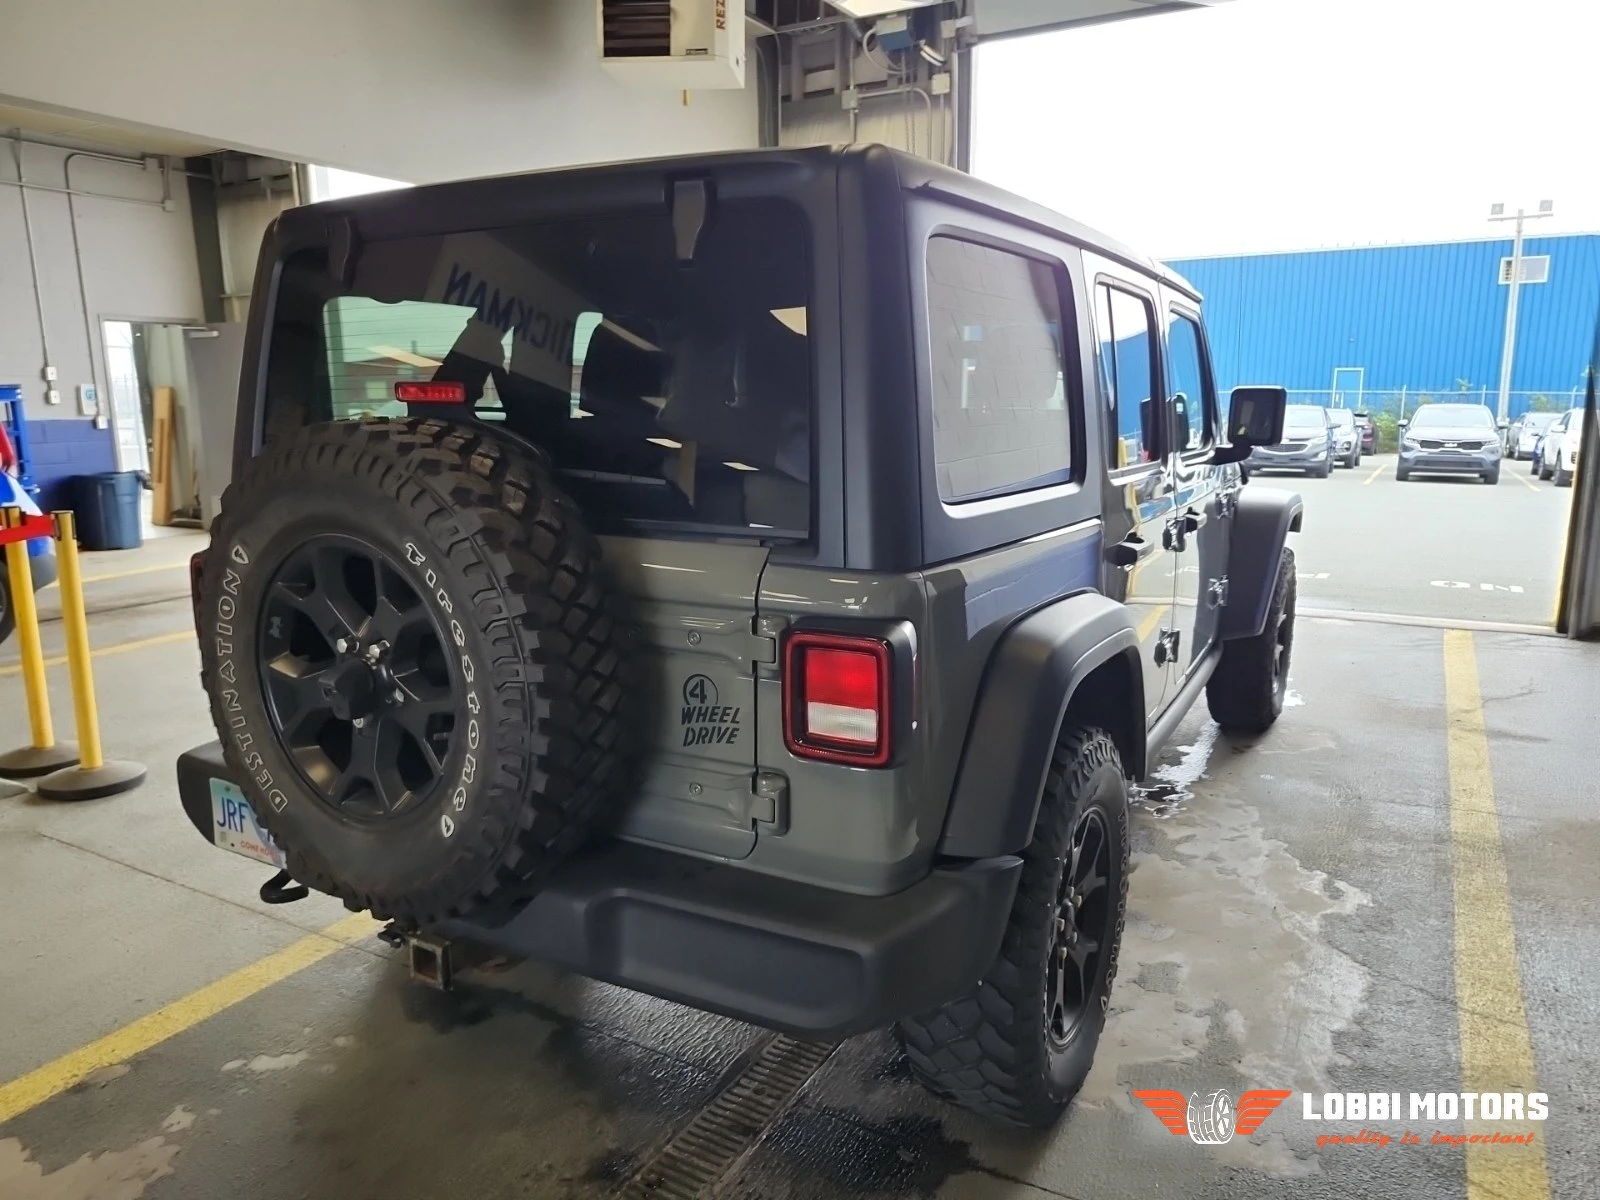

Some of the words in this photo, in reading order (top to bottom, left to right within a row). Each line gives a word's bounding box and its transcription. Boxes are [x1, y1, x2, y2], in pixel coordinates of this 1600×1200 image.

[217, 569, 288, 813] DESTINATION
[681, 706, 741, 725] WHEEL
[683, 726, 740, 747] DRIVE
[217, 797, 248, 833] JRF
